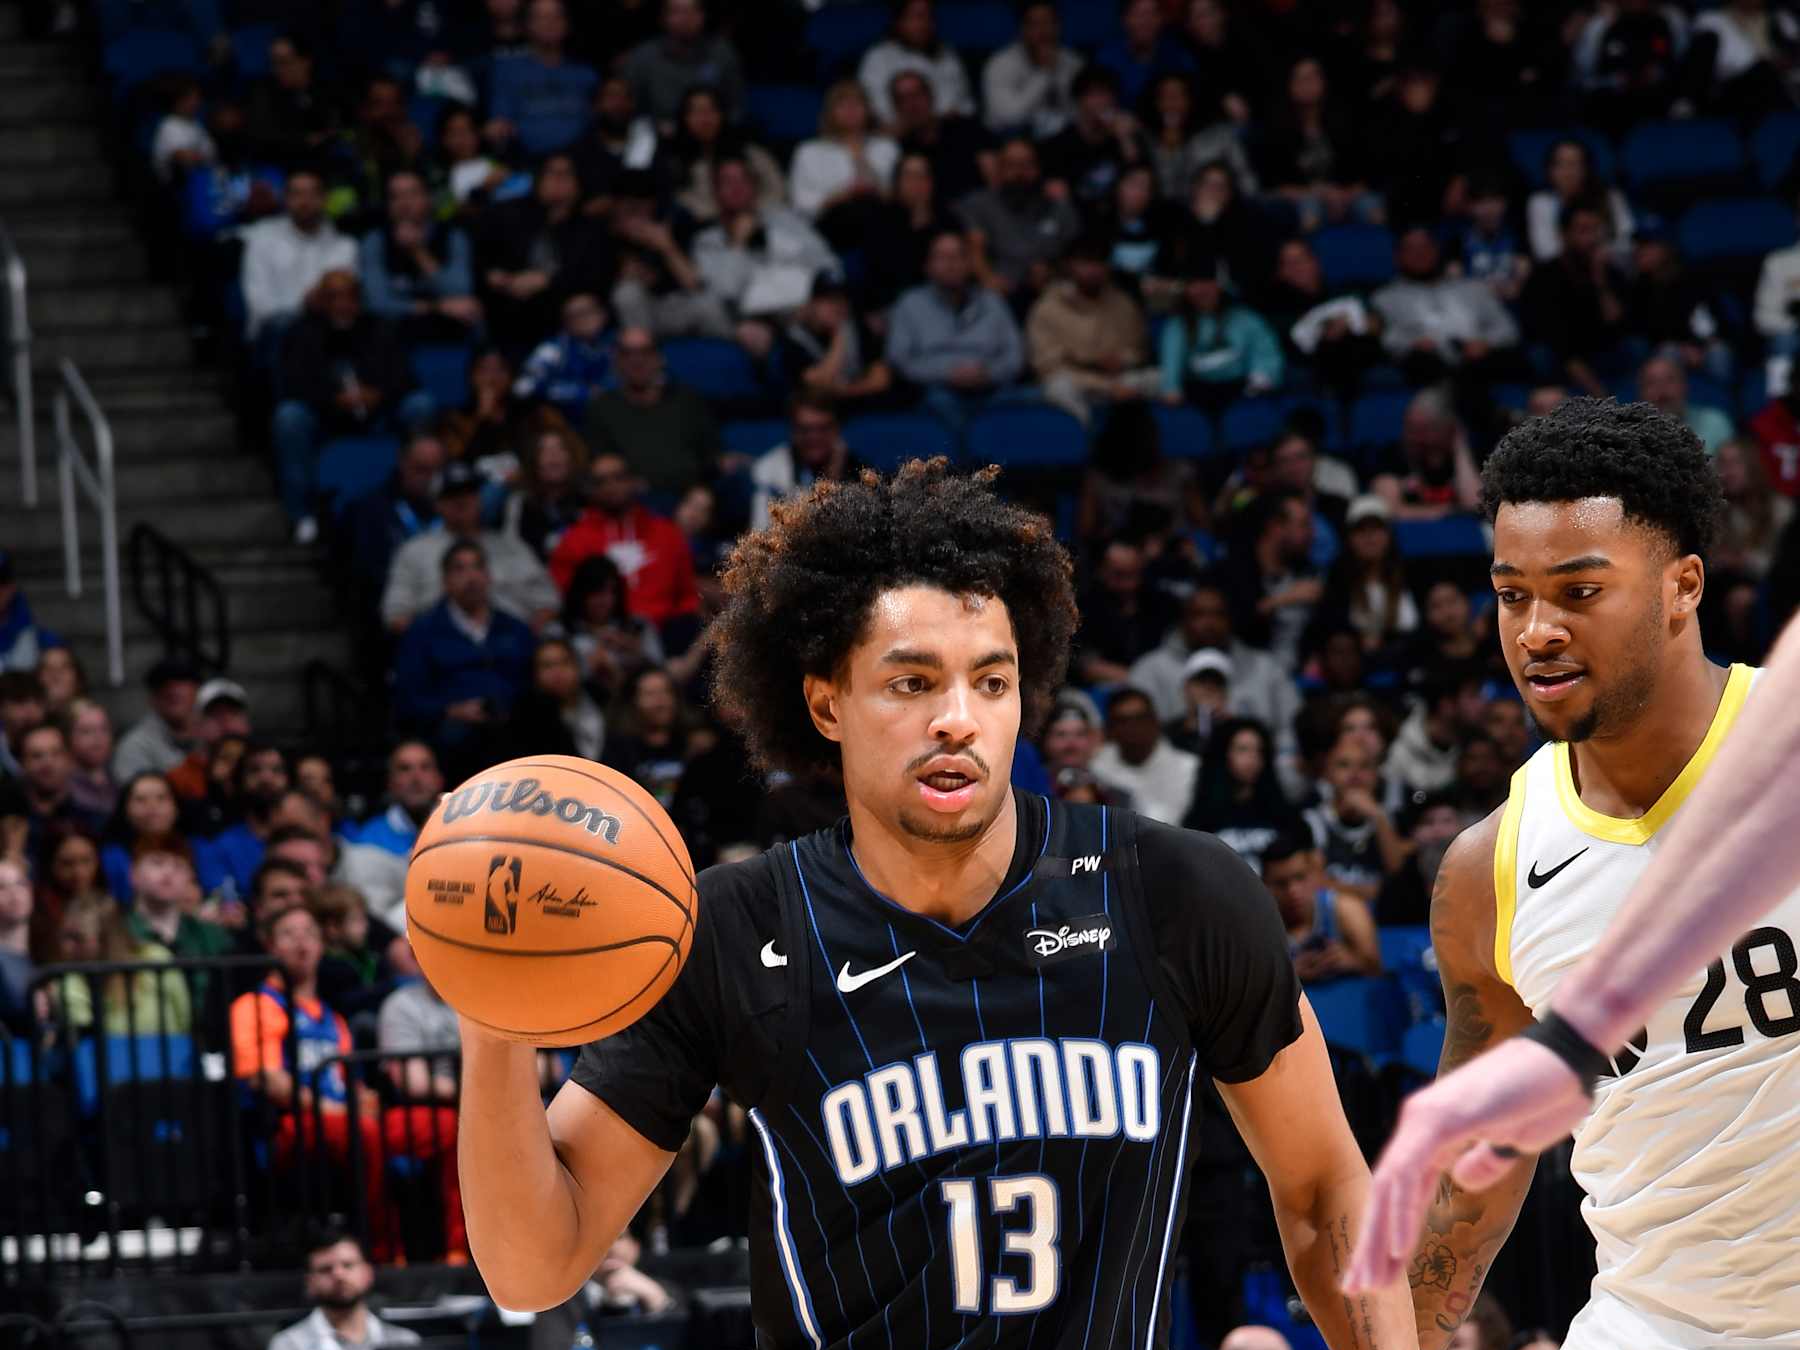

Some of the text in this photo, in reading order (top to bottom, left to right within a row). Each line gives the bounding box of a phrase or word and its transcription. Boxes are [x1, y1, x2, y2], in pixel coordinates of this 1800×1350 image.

[443, 778, 622, 845] Wilson
[1071, 855, 1101, 875] PW
[1027, 925, 1111, 956] Disney
[1683, 926, 1800, 1054] 28
[822, 1037, 1160, 1186] ORLANDO
[938, 1173, 1063, 1315] 13
